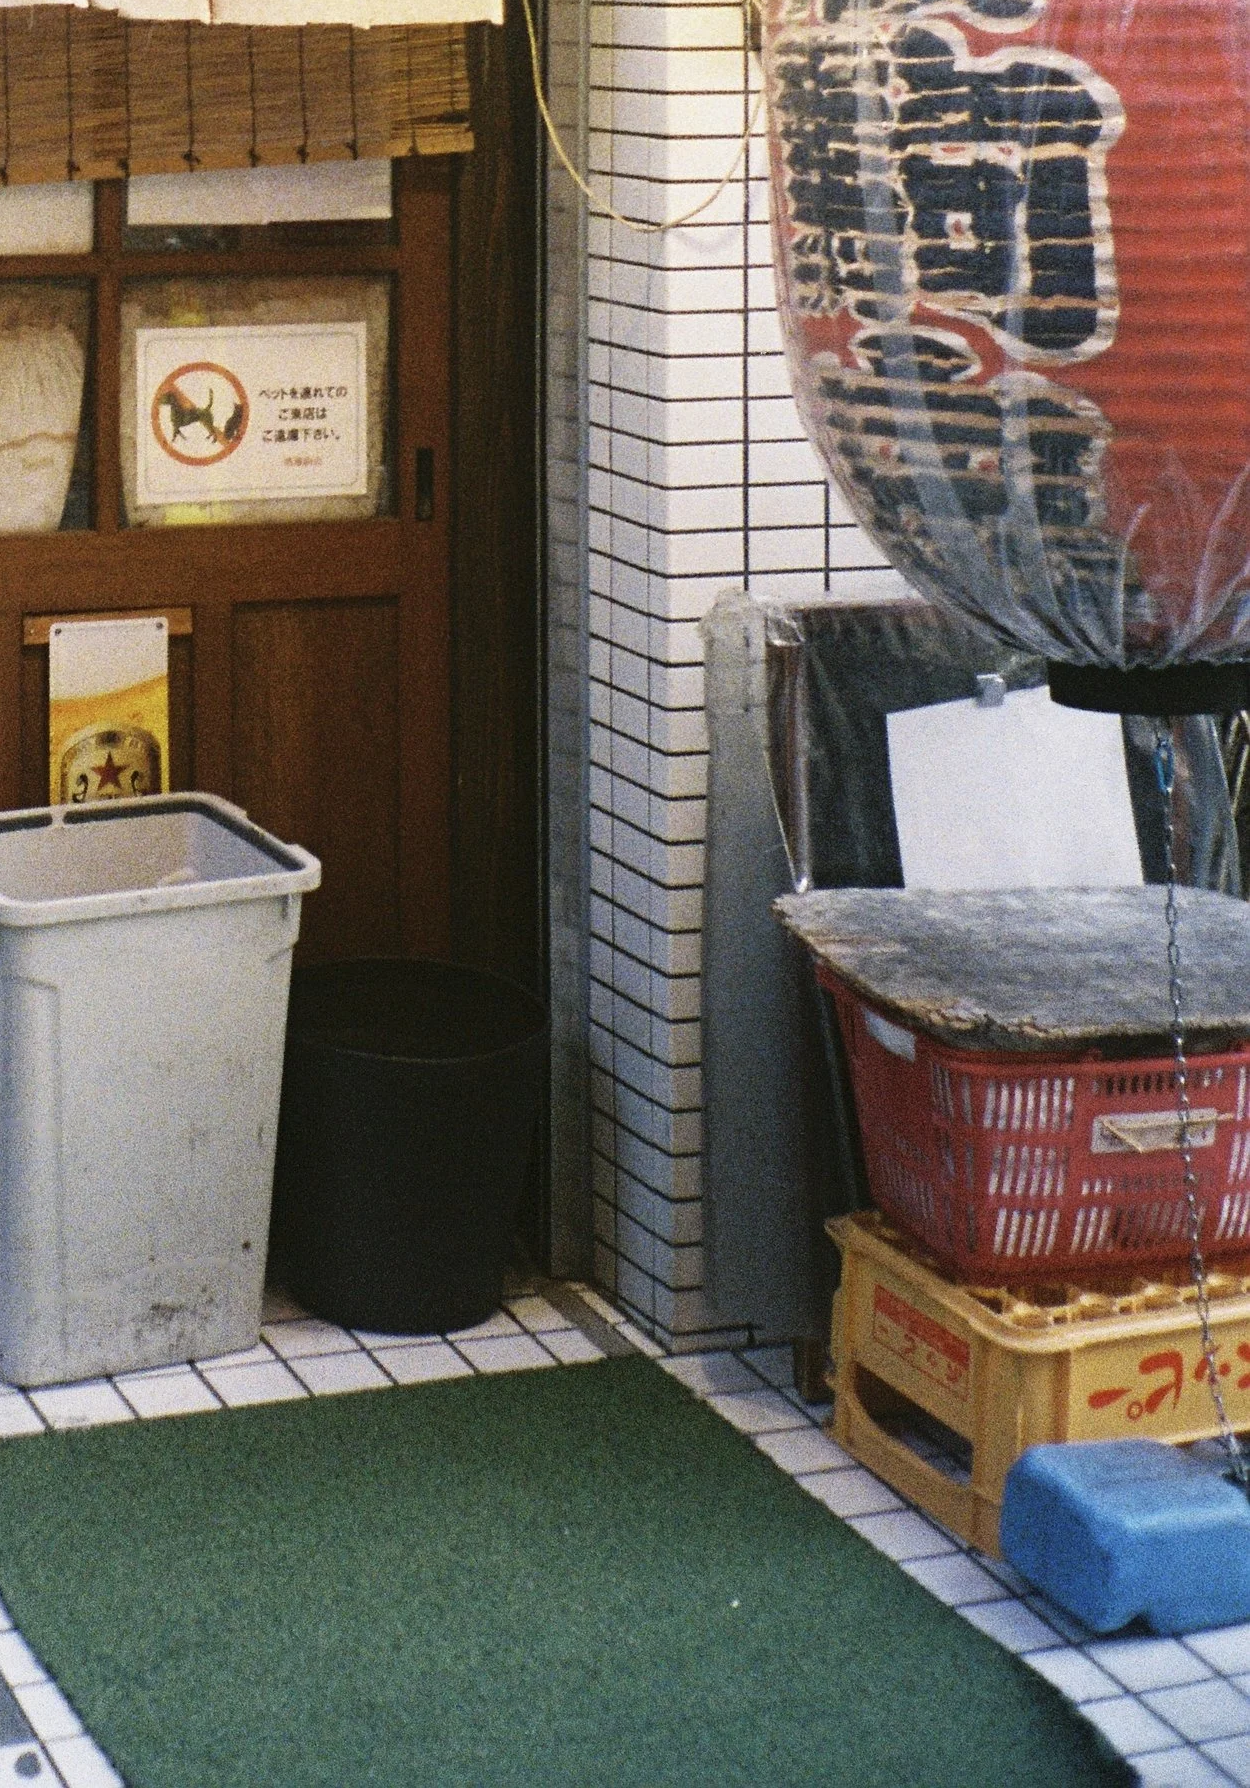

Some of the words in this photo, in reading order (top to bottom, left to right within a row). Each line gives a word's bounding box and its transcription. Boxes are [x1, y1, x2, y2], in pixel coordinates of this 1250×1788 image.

[278, 407, 327, 421] ご来店は
[1087, 1340, 1250, 1423] ッピー
